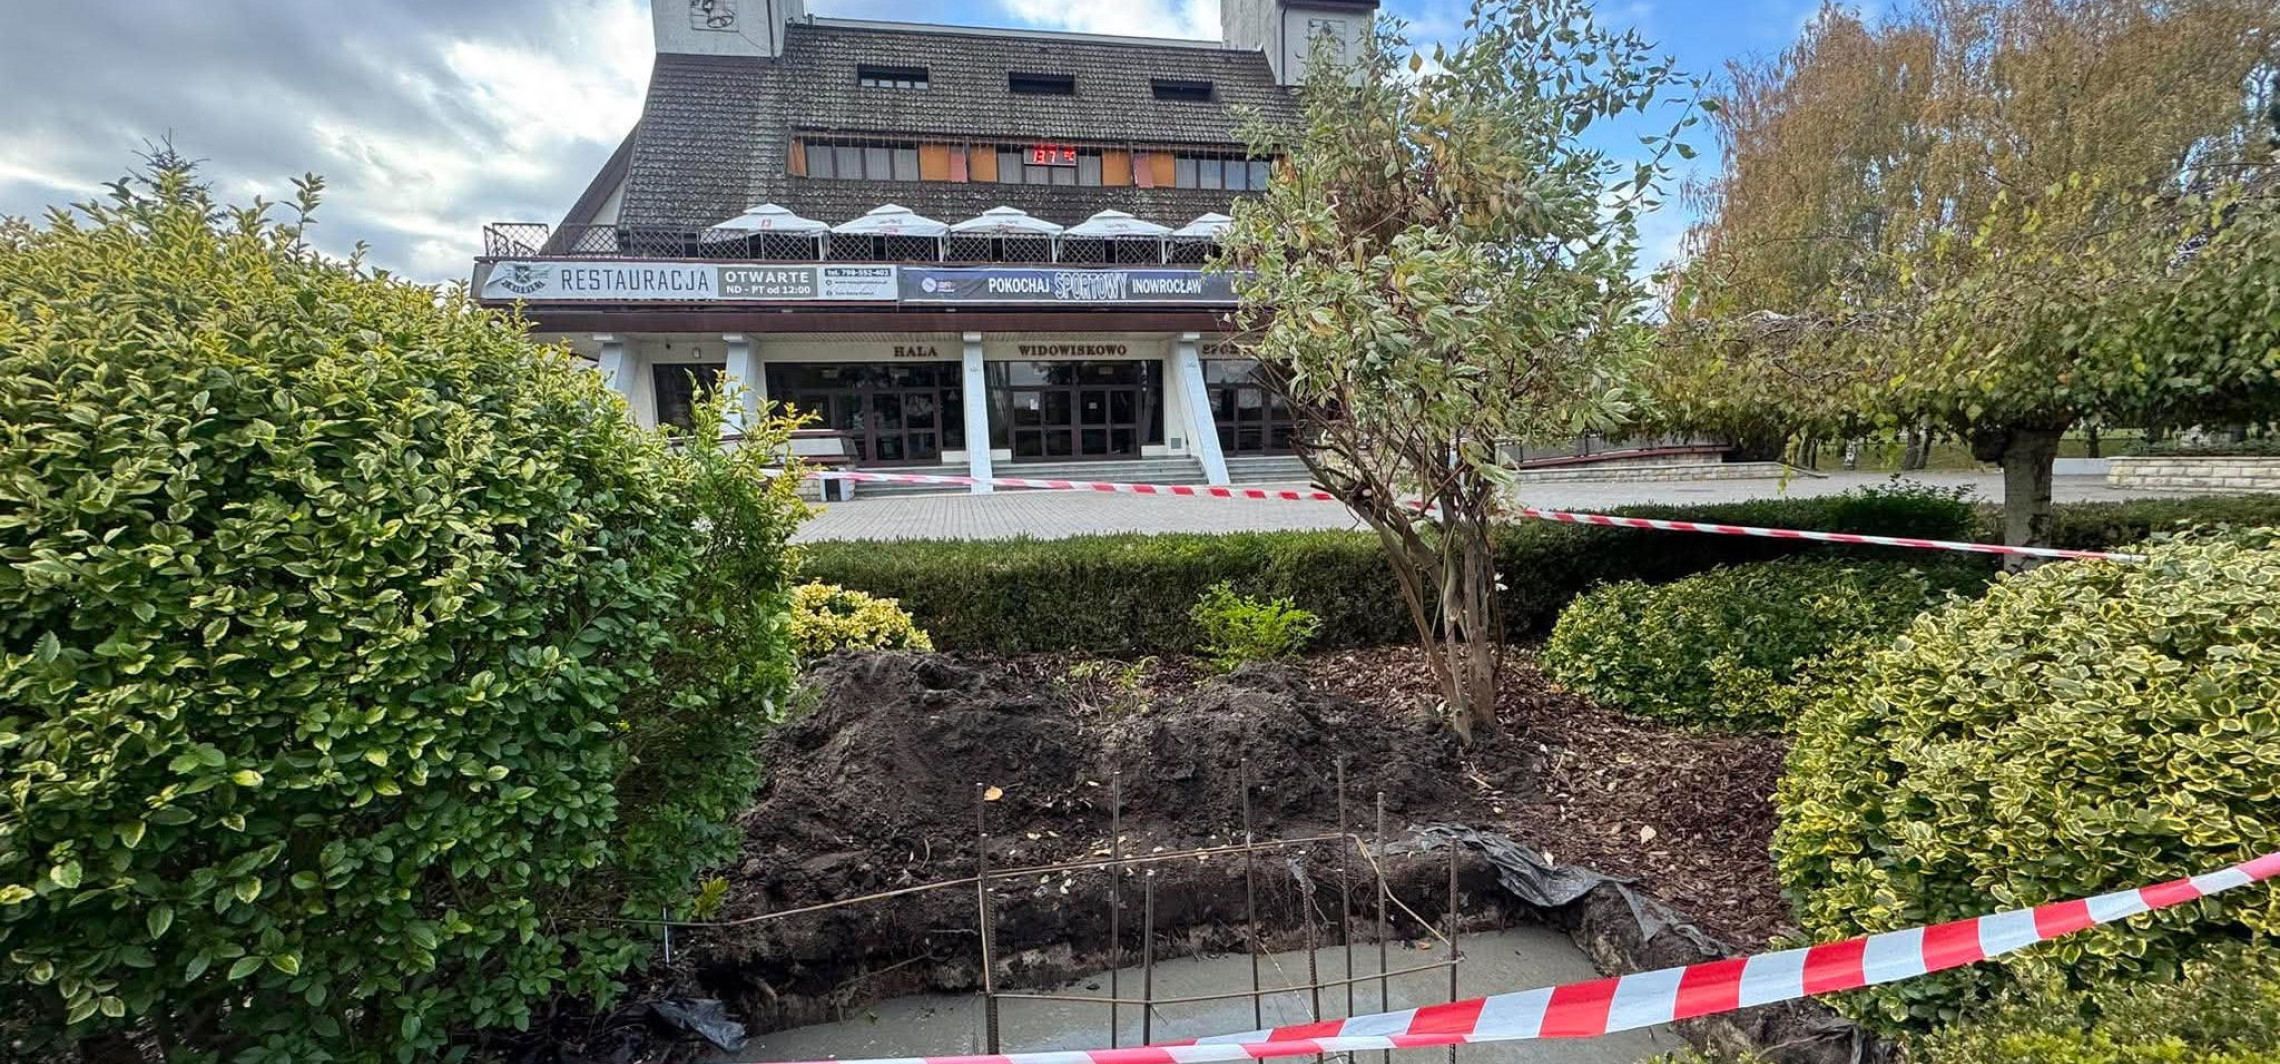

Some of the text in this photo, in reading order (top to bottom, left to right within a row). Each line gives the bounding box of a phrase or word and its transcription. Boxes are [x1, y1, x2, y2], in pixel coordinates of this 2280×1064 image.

[561, 269, 709, 291] RESTAURACJA
[725, 271, 809, 283] OTWARTE
[726, 285, 742, 294] ND
[751, 286, 765, 294] PT
[767, 286, 779, 294] od
[782, 286, 811, 294] 12:00
[988, 272, 1201, 300] POKOCHAJ SPORTOWY INOWROCŁAW
[893, 346, 938, 358] HALA
[1018, 344, 1127, 356] WIDOWISKOWO
